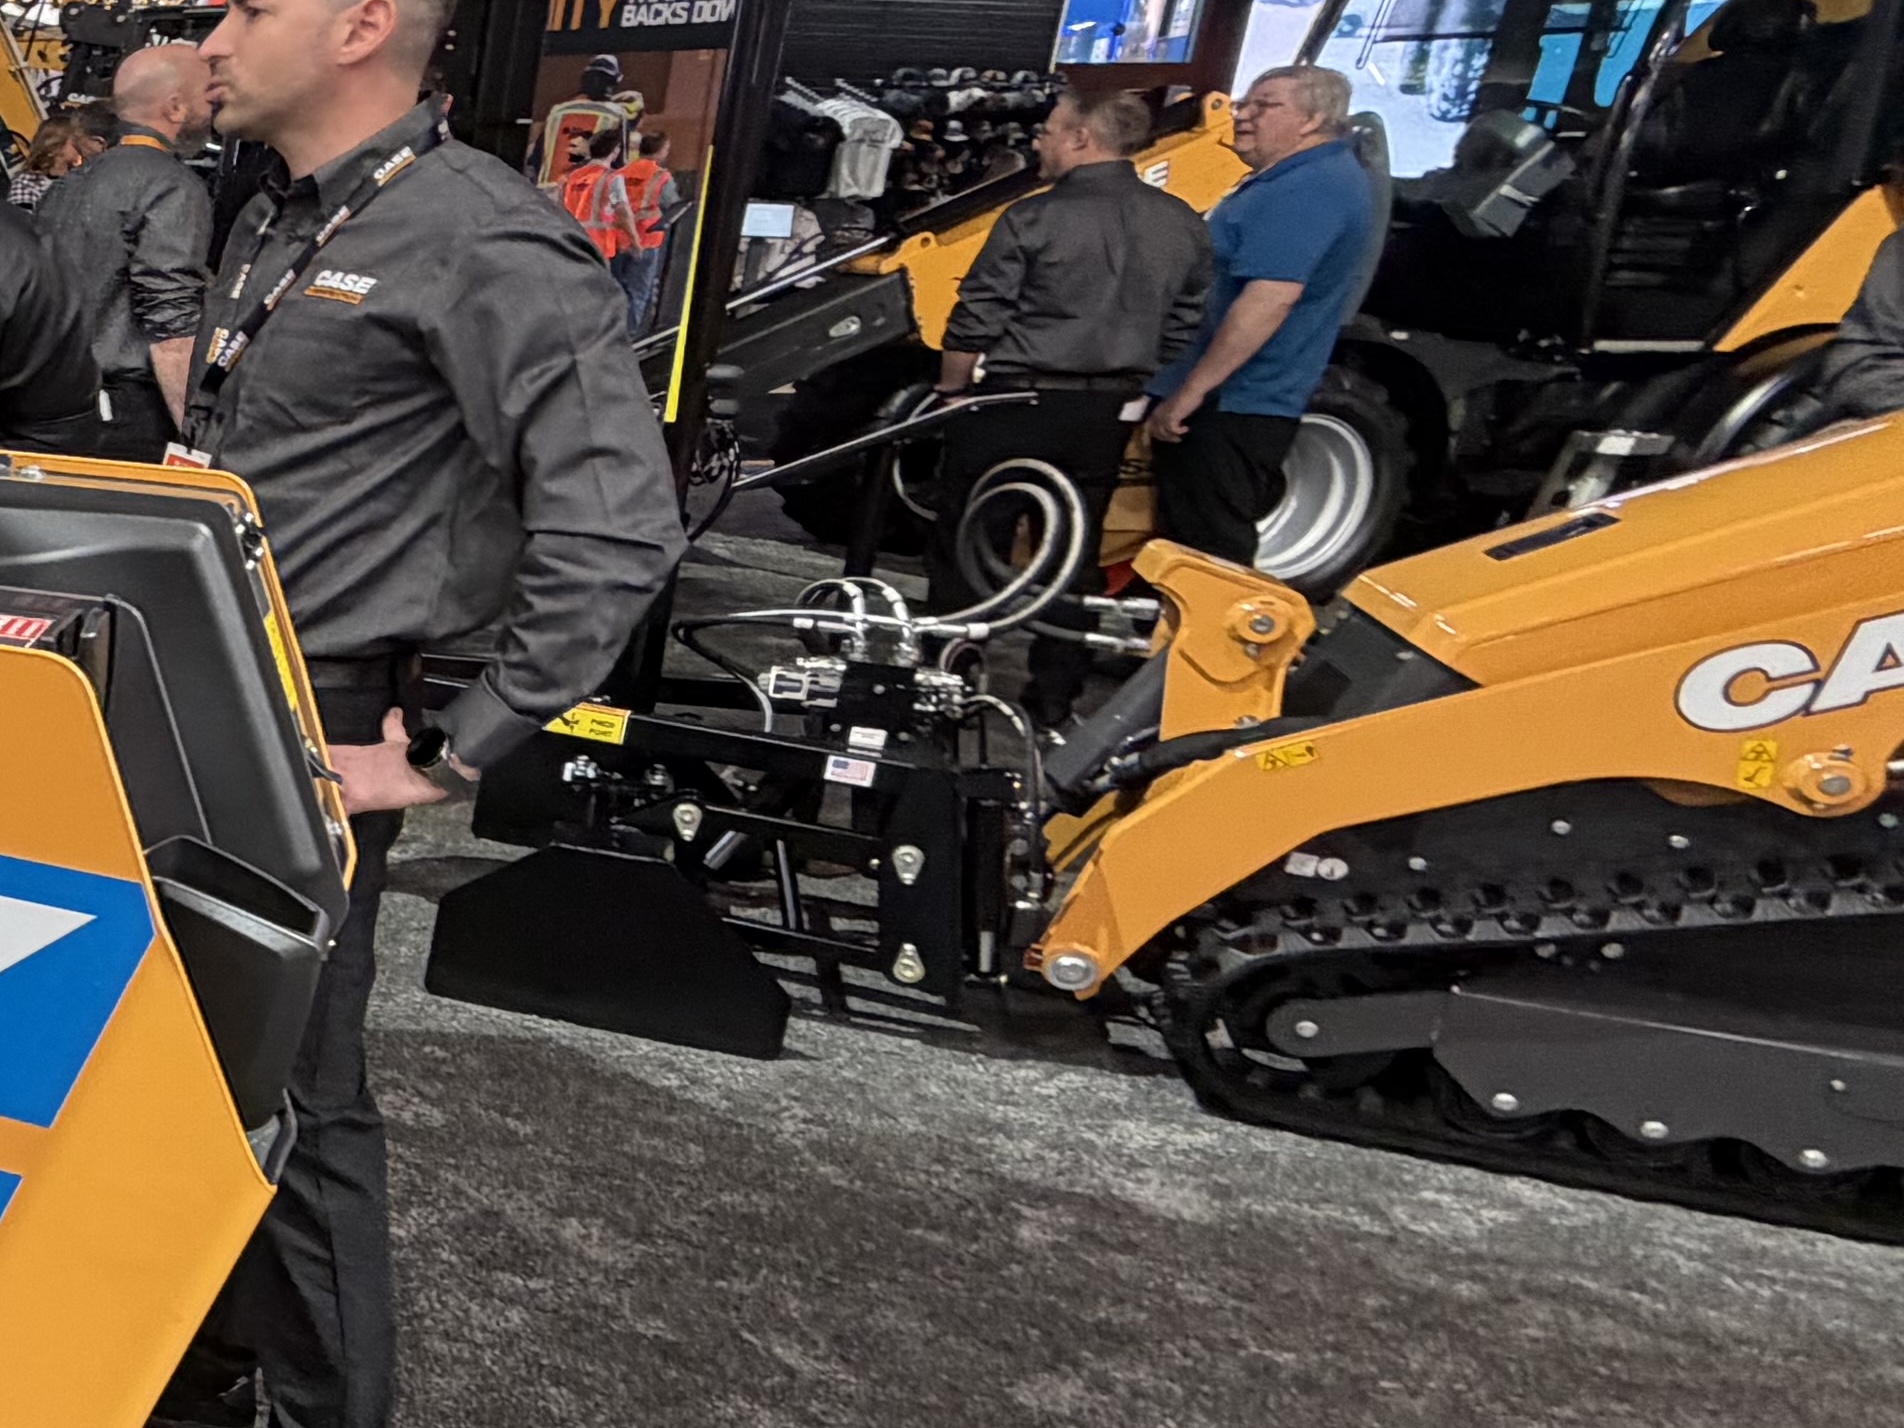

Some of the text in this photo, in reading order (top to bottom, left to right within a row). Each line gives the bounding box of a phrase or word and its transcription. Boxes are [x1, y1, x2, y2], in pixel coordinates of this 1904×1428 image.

[620, 0, 737, 28] BACKS DOW
[314, 269, 377, 294] CASE
[1674, 609, 1904, 733] CA
